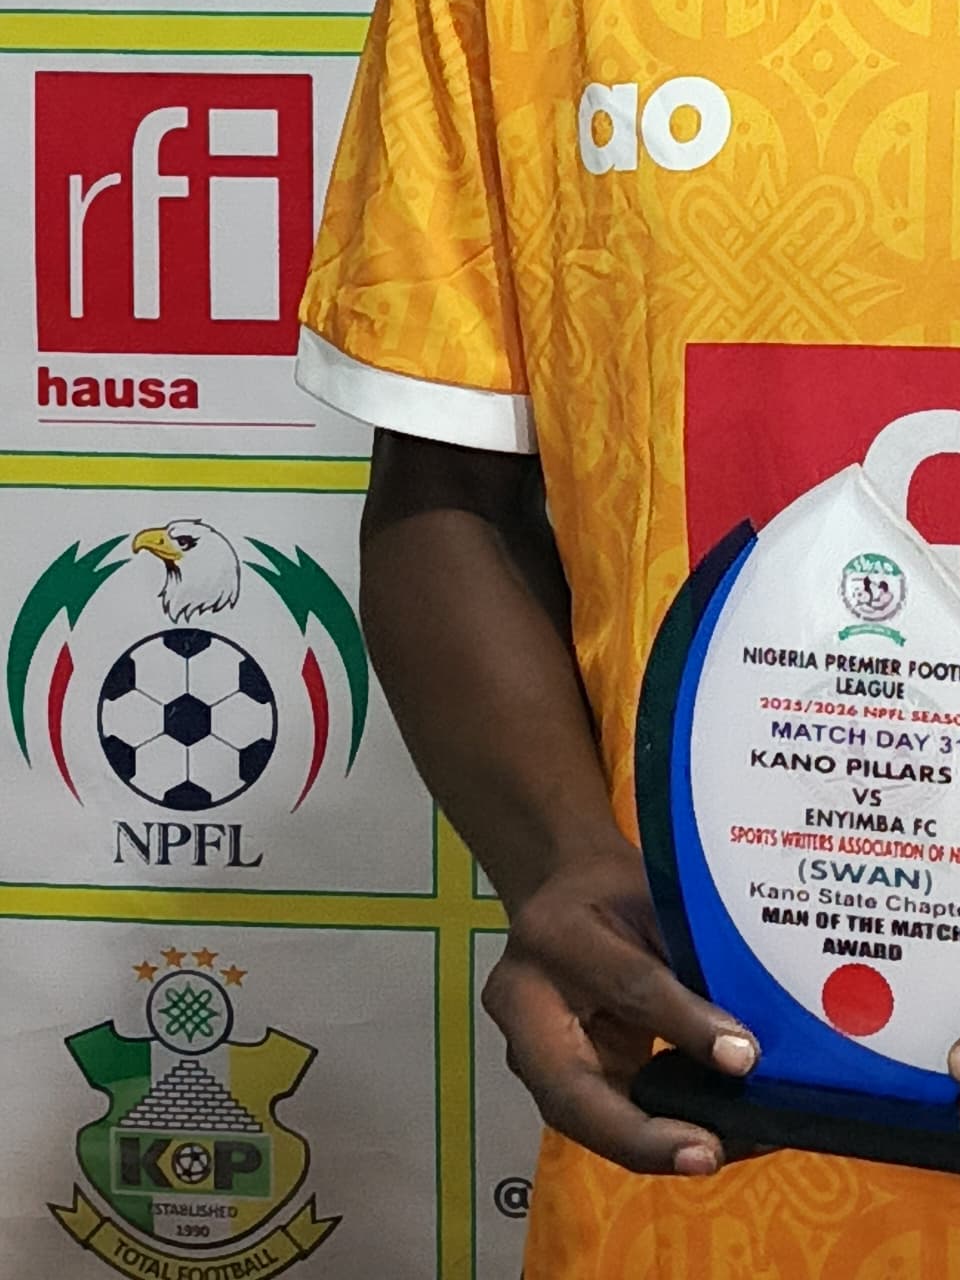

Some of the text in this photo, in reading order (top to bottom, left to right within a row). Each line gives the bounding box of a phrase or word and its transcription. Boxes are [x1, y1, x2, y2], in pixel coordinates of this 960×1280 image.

[69, 106, 280, 320] rfi
[38, 366, 199, 409] hausa
[743, 647, 818, 671] NIGERIA
[825, 653, 901, 677] PREMIER
[836, 677, 904, 700] LEAGUE
[863, 705, 905, 722] NPFL
[771, 721, 866, 746] MATCH
[877, 730, 930, 752] DAY
[751, 748, 836, 774] KANO
[846, 757, 952, 785] PILLARS
[852, 787, 882, 807] VS
[805, 808, 936, 838] ENYIMBA FC
[112, 820, 264, 869] NPFL
[730, 825, 777, 847] SPORTS
[781, 830, 834, 853] WRITERS
[838, 836, 924, 861] ASSOCIATION
[928, 844, 945, 863] OF
[798, 857, 933, 896] (SWAN)
[750, 881, 810, 903] Kano
[818, 888, 878, 910] State
[762, 906, 809, 928] MAN
[816, 911, 841, 930] OF
[847, 914, 884, 935] THE
[822, 937, 902, 962] AWARD
[175, 1224, 210, 1238] 1990
[113, 1237, 174, 1280] TOTAL
